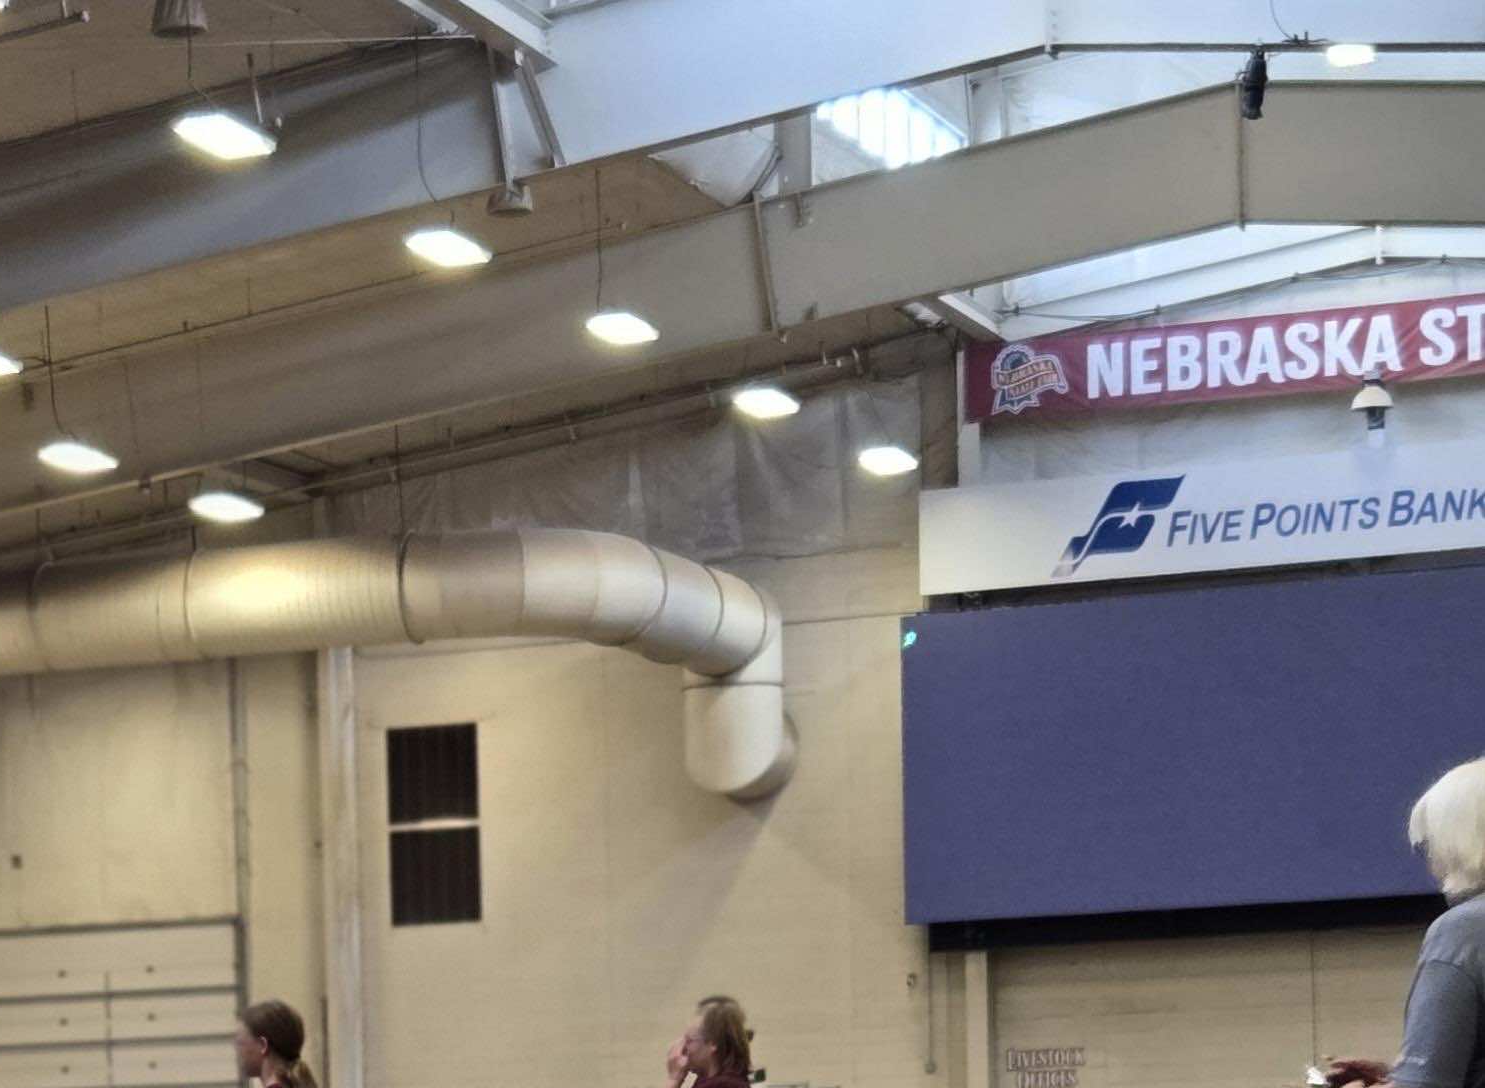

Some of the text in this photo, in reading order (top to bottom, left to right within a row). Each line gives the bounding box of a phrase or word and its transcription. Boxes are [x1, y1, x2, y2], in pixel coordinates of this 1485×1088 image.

[1087, 304, 1485, 399] NEBRASKA ST
[1167, 488, 1485, 548] FIVE POINTS BANK
[1007, 1048, 1085, 1071] LIVESTOCK
